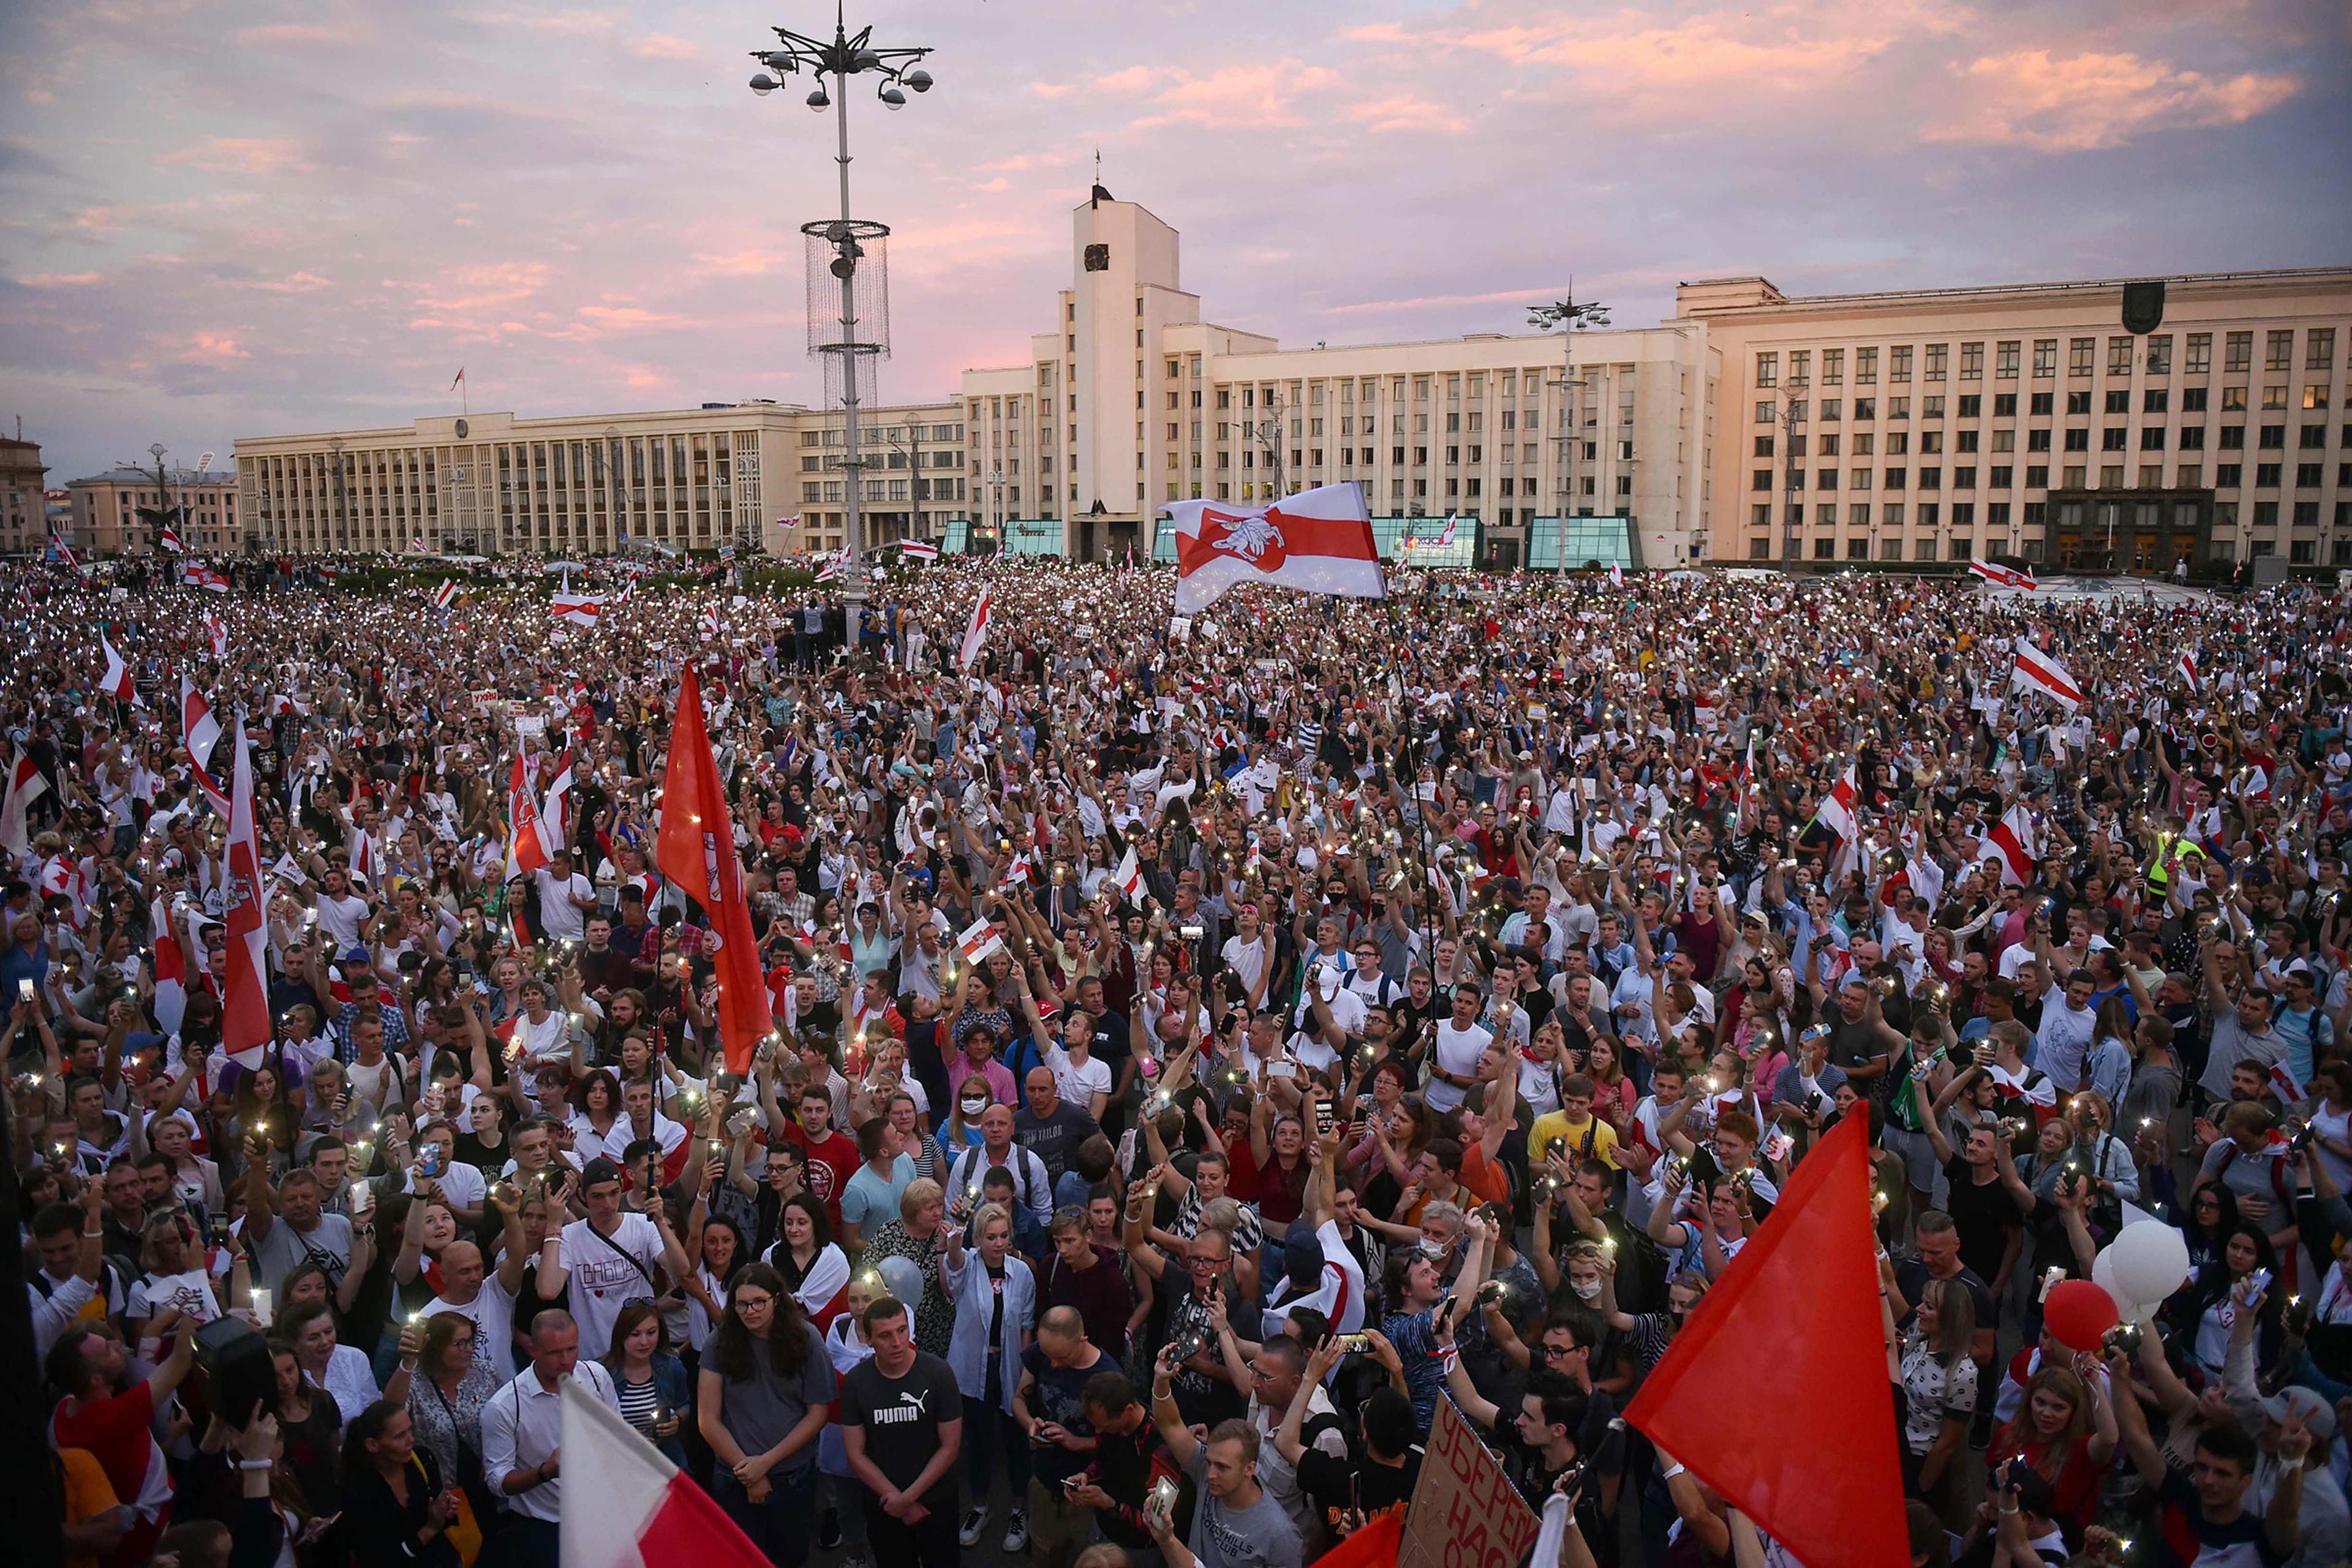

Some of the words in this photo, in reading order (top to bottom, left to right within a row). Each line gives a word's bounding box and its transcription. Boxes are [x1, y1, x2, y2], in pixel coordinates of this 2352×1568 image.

[1038, 1125, 1063, 1142] TAILOR
[874, 1406, 918, 1425] PUMA
[1215, 1537, 1238, 1557] CLUB
